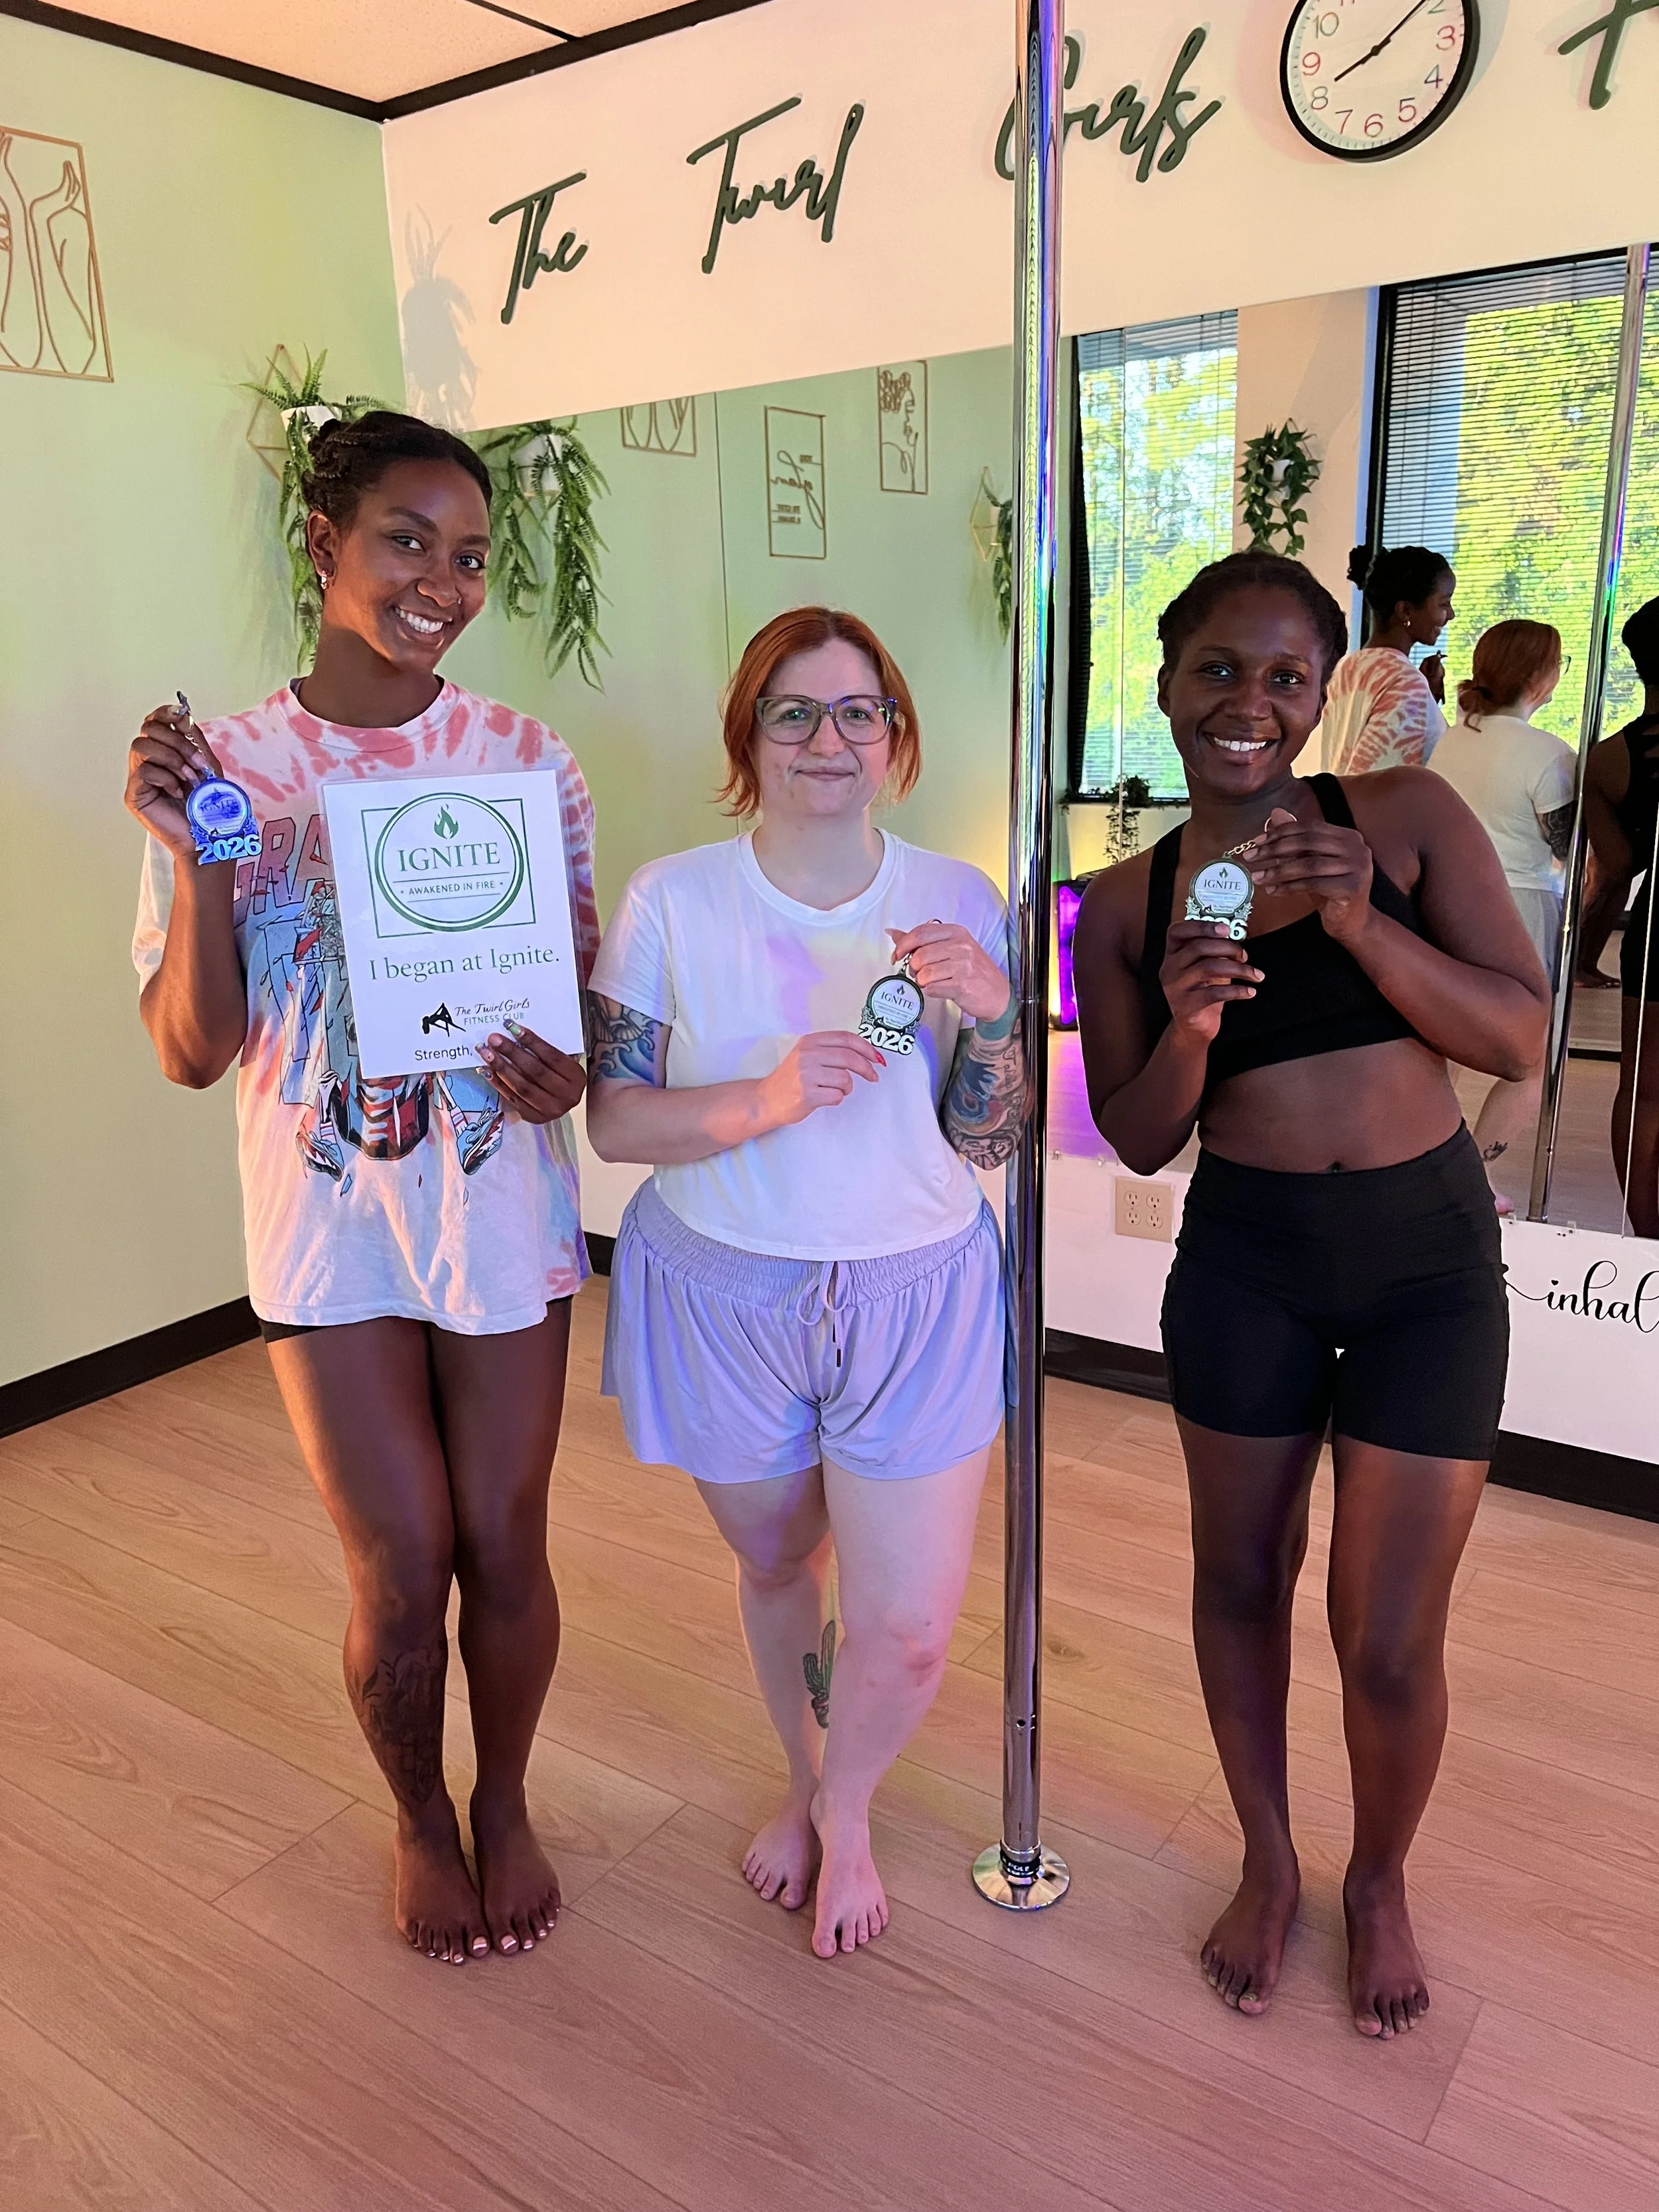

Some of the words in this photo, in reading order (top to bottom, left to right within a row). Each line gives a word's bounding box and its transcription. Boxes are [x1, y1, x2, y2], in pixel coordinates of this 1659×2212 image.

[1314, 12, 1339, 38] 10
[1436, 25, 1455, 50] 3
[1302, 52, 1321, 76] 9
[1424, 64, 1443, 88] 4
[1311, 86, 1329, 110] 8
[1398, 98, 1417, 122] 5
[1335, 110, 1353, 134] 7
[1364, 113, 1383, 138] 6
[489, 169, 589, 325] The
[686, 96, 864, 274] Twirl
[196, 834, 262, 865] 2026
[397, 842, 500, 871] IGNITE
[409, 883, 460, 895] AWAKENED
[464, 882, 472, 891] IN
[476, 881, 496, 890] FIRE
[1204, 879, 1242, 891] IGNITE
[369, 960, 377, 980] I
[384, 957, 455, 983] began
[462, 954, 482, 971] at
[490, 946, 559, 974] Ignite.
[455, 1006, 471, 1016] The
[474, 1001, 504, 1014] Twirl
[504, 997, 530, 1011] Girls
[881, 992, 914, 1009] IGNITE
[465, 1015, 500, 1025] FITNESS
[859, 1023, 915, 1055] 2026
